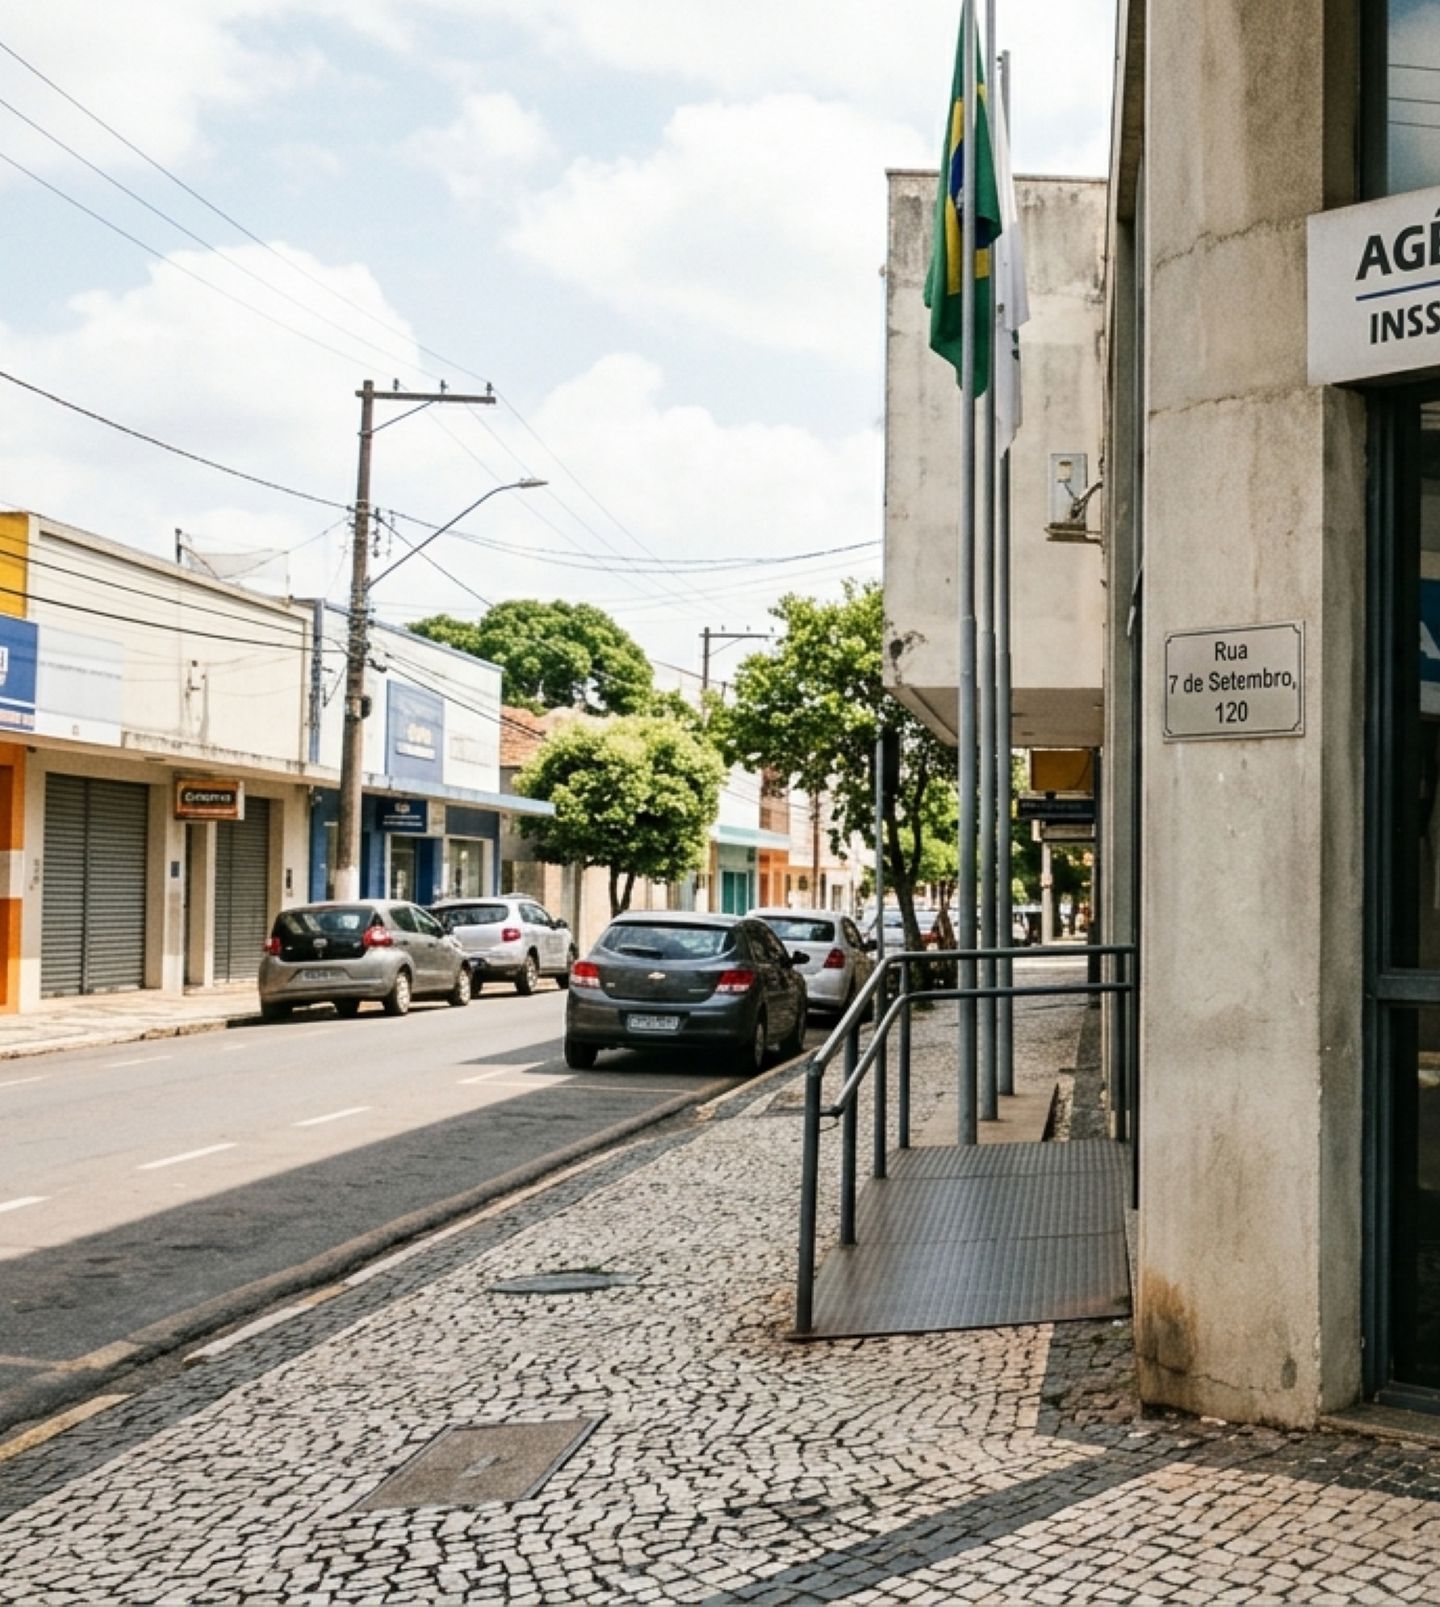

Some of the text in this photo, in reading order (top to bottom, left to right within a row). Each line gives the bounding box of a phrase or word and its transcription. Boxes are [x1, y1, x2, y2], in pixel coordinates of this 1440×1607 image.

[1214, 641, 1248, 662] Rua
[1169, 667, 1297, 694] 7 de Setembro,
[1214, 700, 1248, 724] 120
